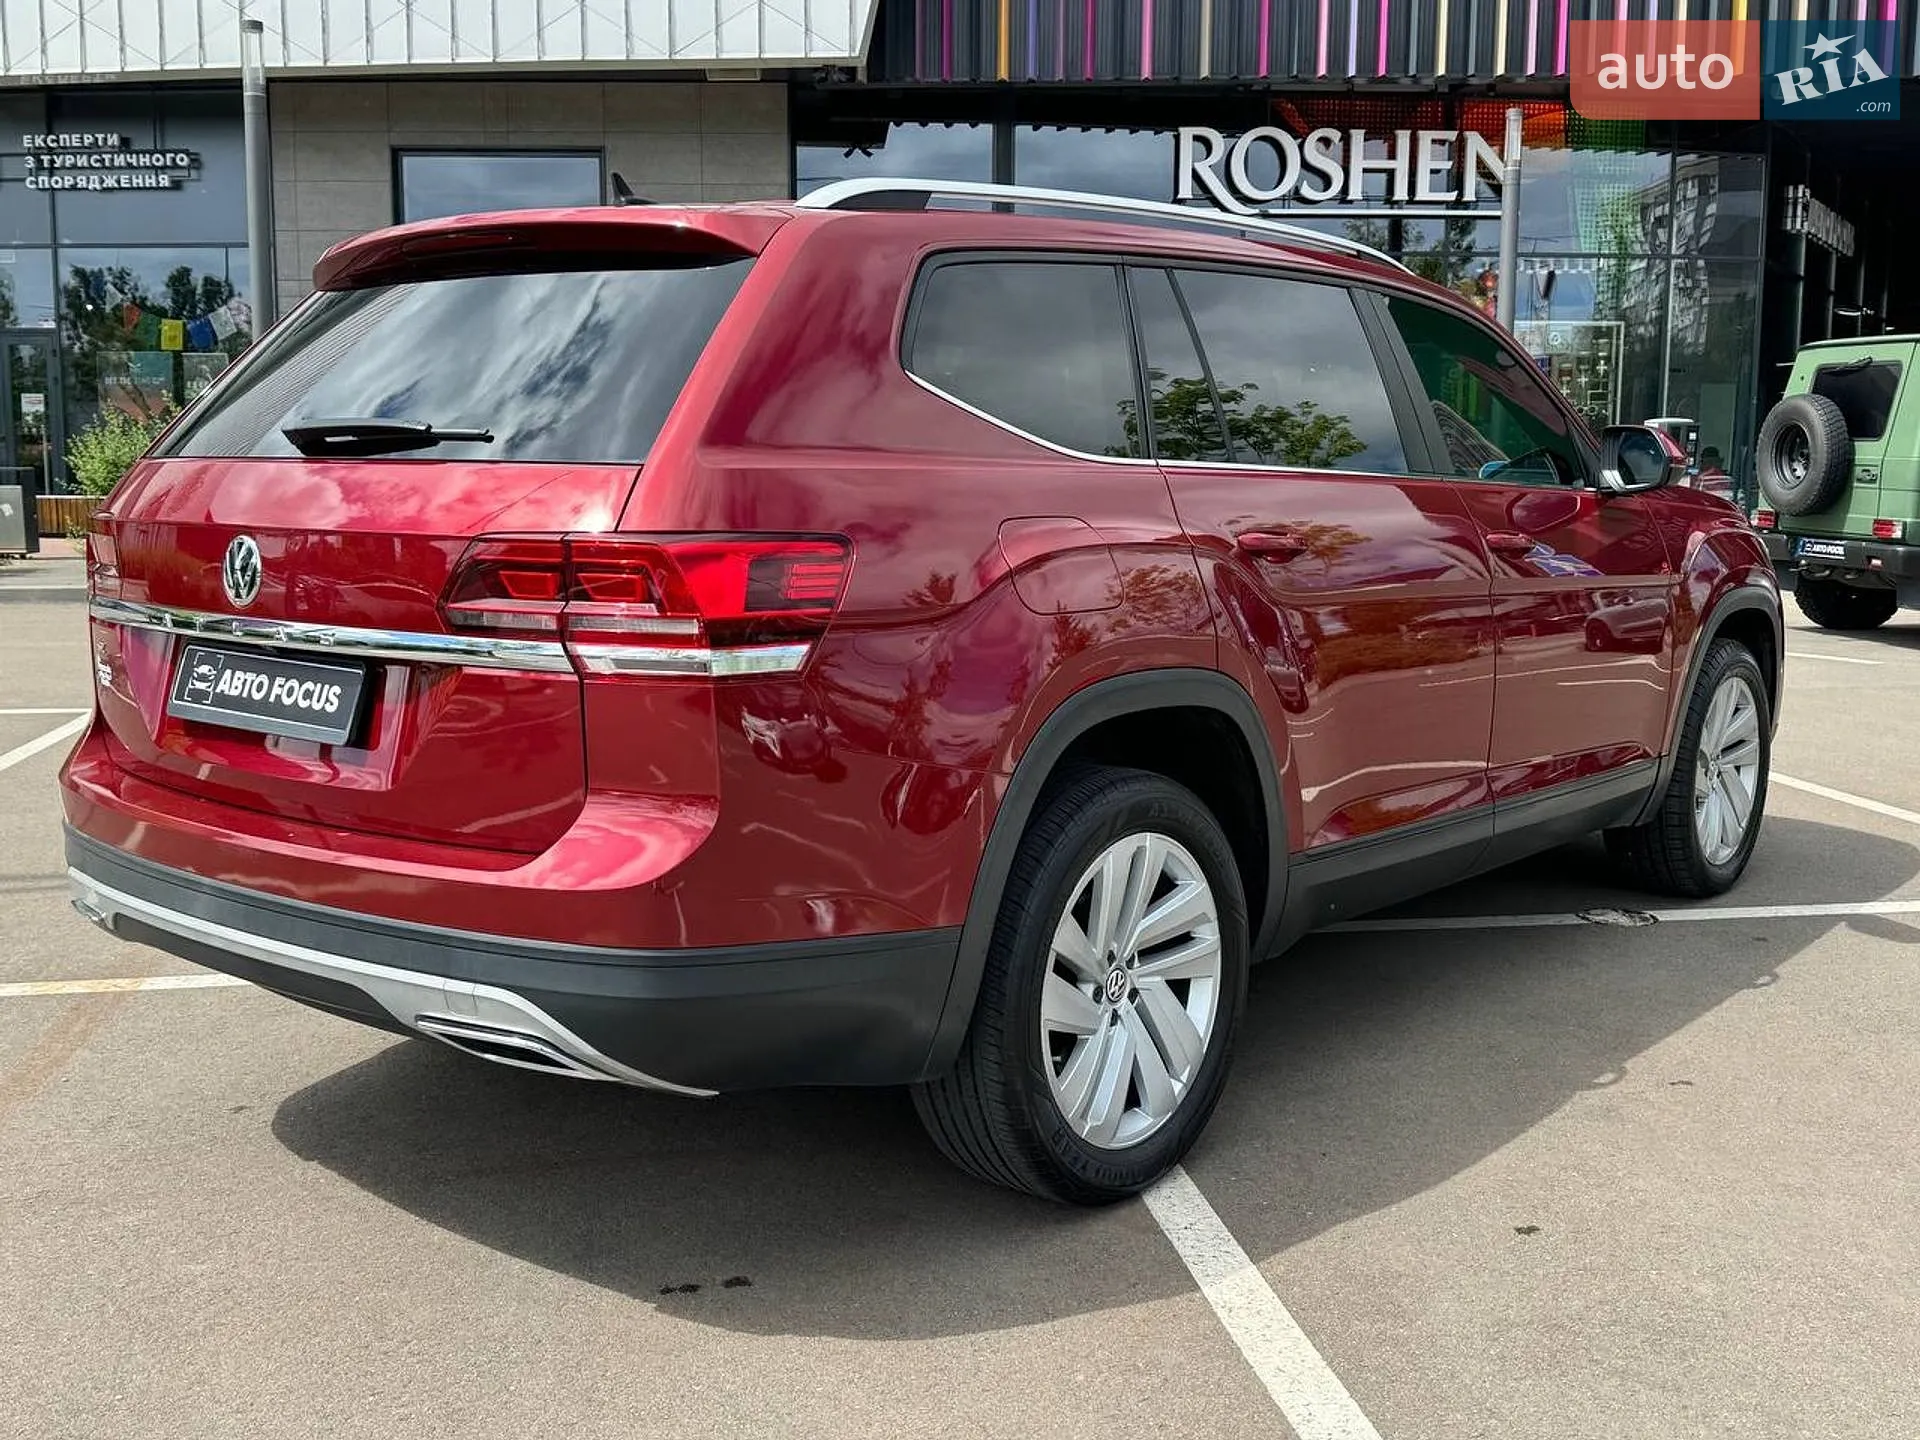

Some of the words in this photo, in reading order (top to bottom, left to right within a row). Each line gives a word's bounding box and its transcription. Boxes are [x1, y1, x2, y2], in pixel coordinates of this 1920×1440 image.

[22, 133, 120, 148] ЕКСПЕРТИ
[41, 153, 190, 168] ТУРИСТИЧНОГО
[1176, 126, 1505, 215] ROSHEN
[25, 174, 170, 191] СПОРЯДЖЕННЯ
[215, 669, 269, 701] АВТО
[268, 676, 342, 713] FOCUS
